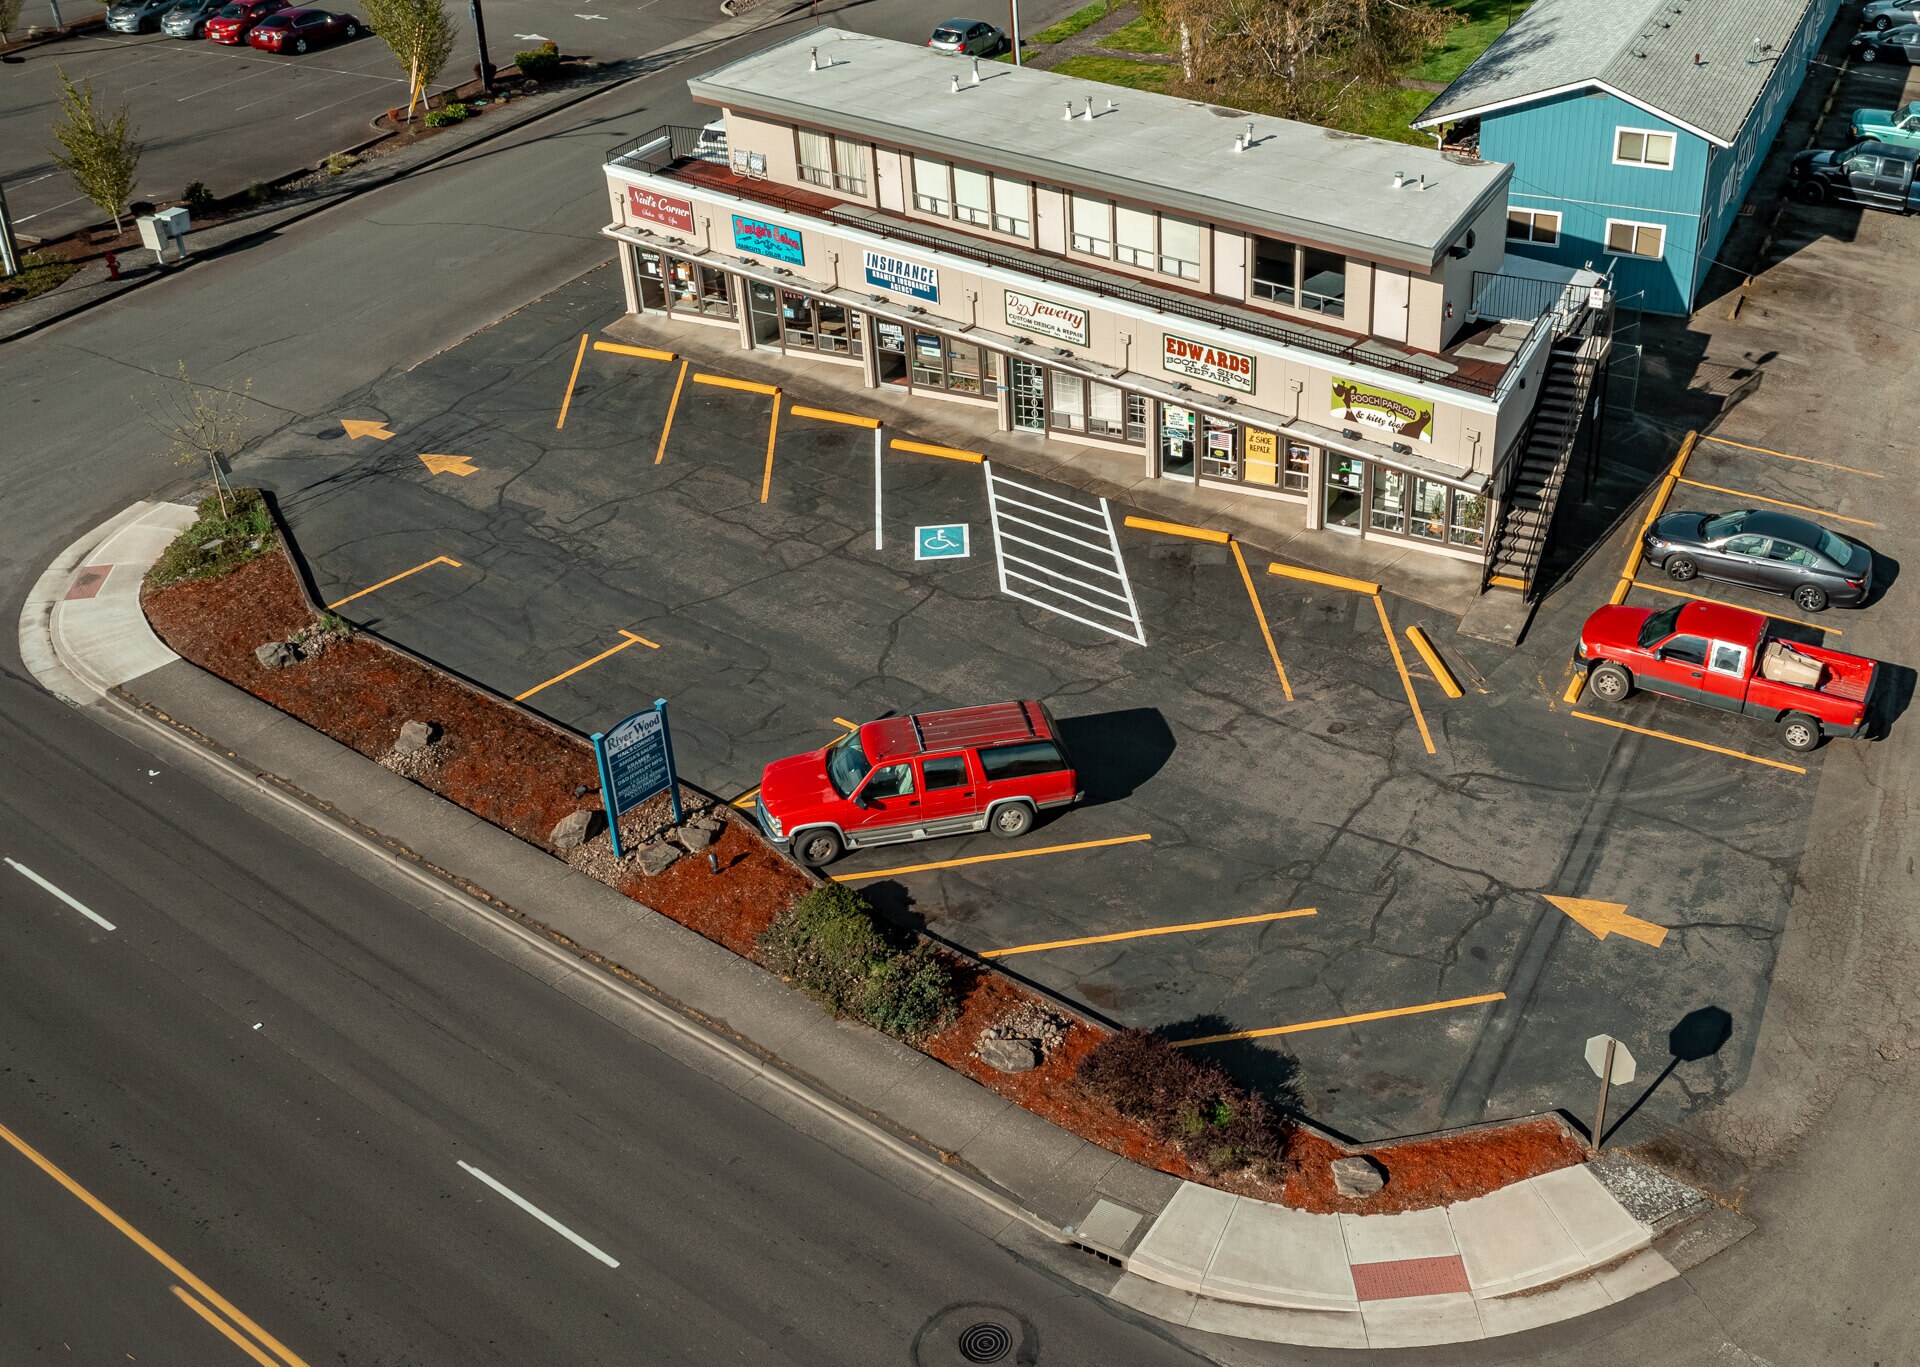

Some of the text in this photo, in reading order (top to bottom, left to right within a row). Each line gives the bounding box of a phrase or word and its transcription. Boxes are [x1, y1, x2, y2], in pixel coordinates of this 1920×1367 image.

[630, 191, 690, 217] Nail's Corner
[736, 218, 800, 250] Amiga's Salon
[737, 244, 761, 254] HAIRCUTS
[765, 250, 781, 260] COLOR
[867, 252, 934, 284] INSURANCE
[872, 270, 930, 293] KRAMER INSURANCE
[890, 282, 913, 295] AGENCY
[1009, 314, 1032, 325] CUSTOM
[1034, 320, 1055, 331] DESIGN
[1062, 328, 1084, 338] REPAIR
[1028, 300, 1084, 329] Jewelry
[1166, 337, 1250, 375] EDWARDS
[1166, 356, 1198, 368] BOOT
[1217, 368, 1250, 386] SHOE
[1184, 366, 1230, 384] REPAIR
[1351, 394, 1416, 419] POOCH PARLOR
[1356, 410, 1405, 431] & kitty too!
[1250, 444, 1271, 454] REPAIR
[1256, 436, 1272, 445] SHOE
[608, 714, 660, 751] River Wood
[618, 735, 655, 759] NAIL'S CORNER
[640, 742, 658, 756] SALON
[627, 754, 650, 770] KRAMER
